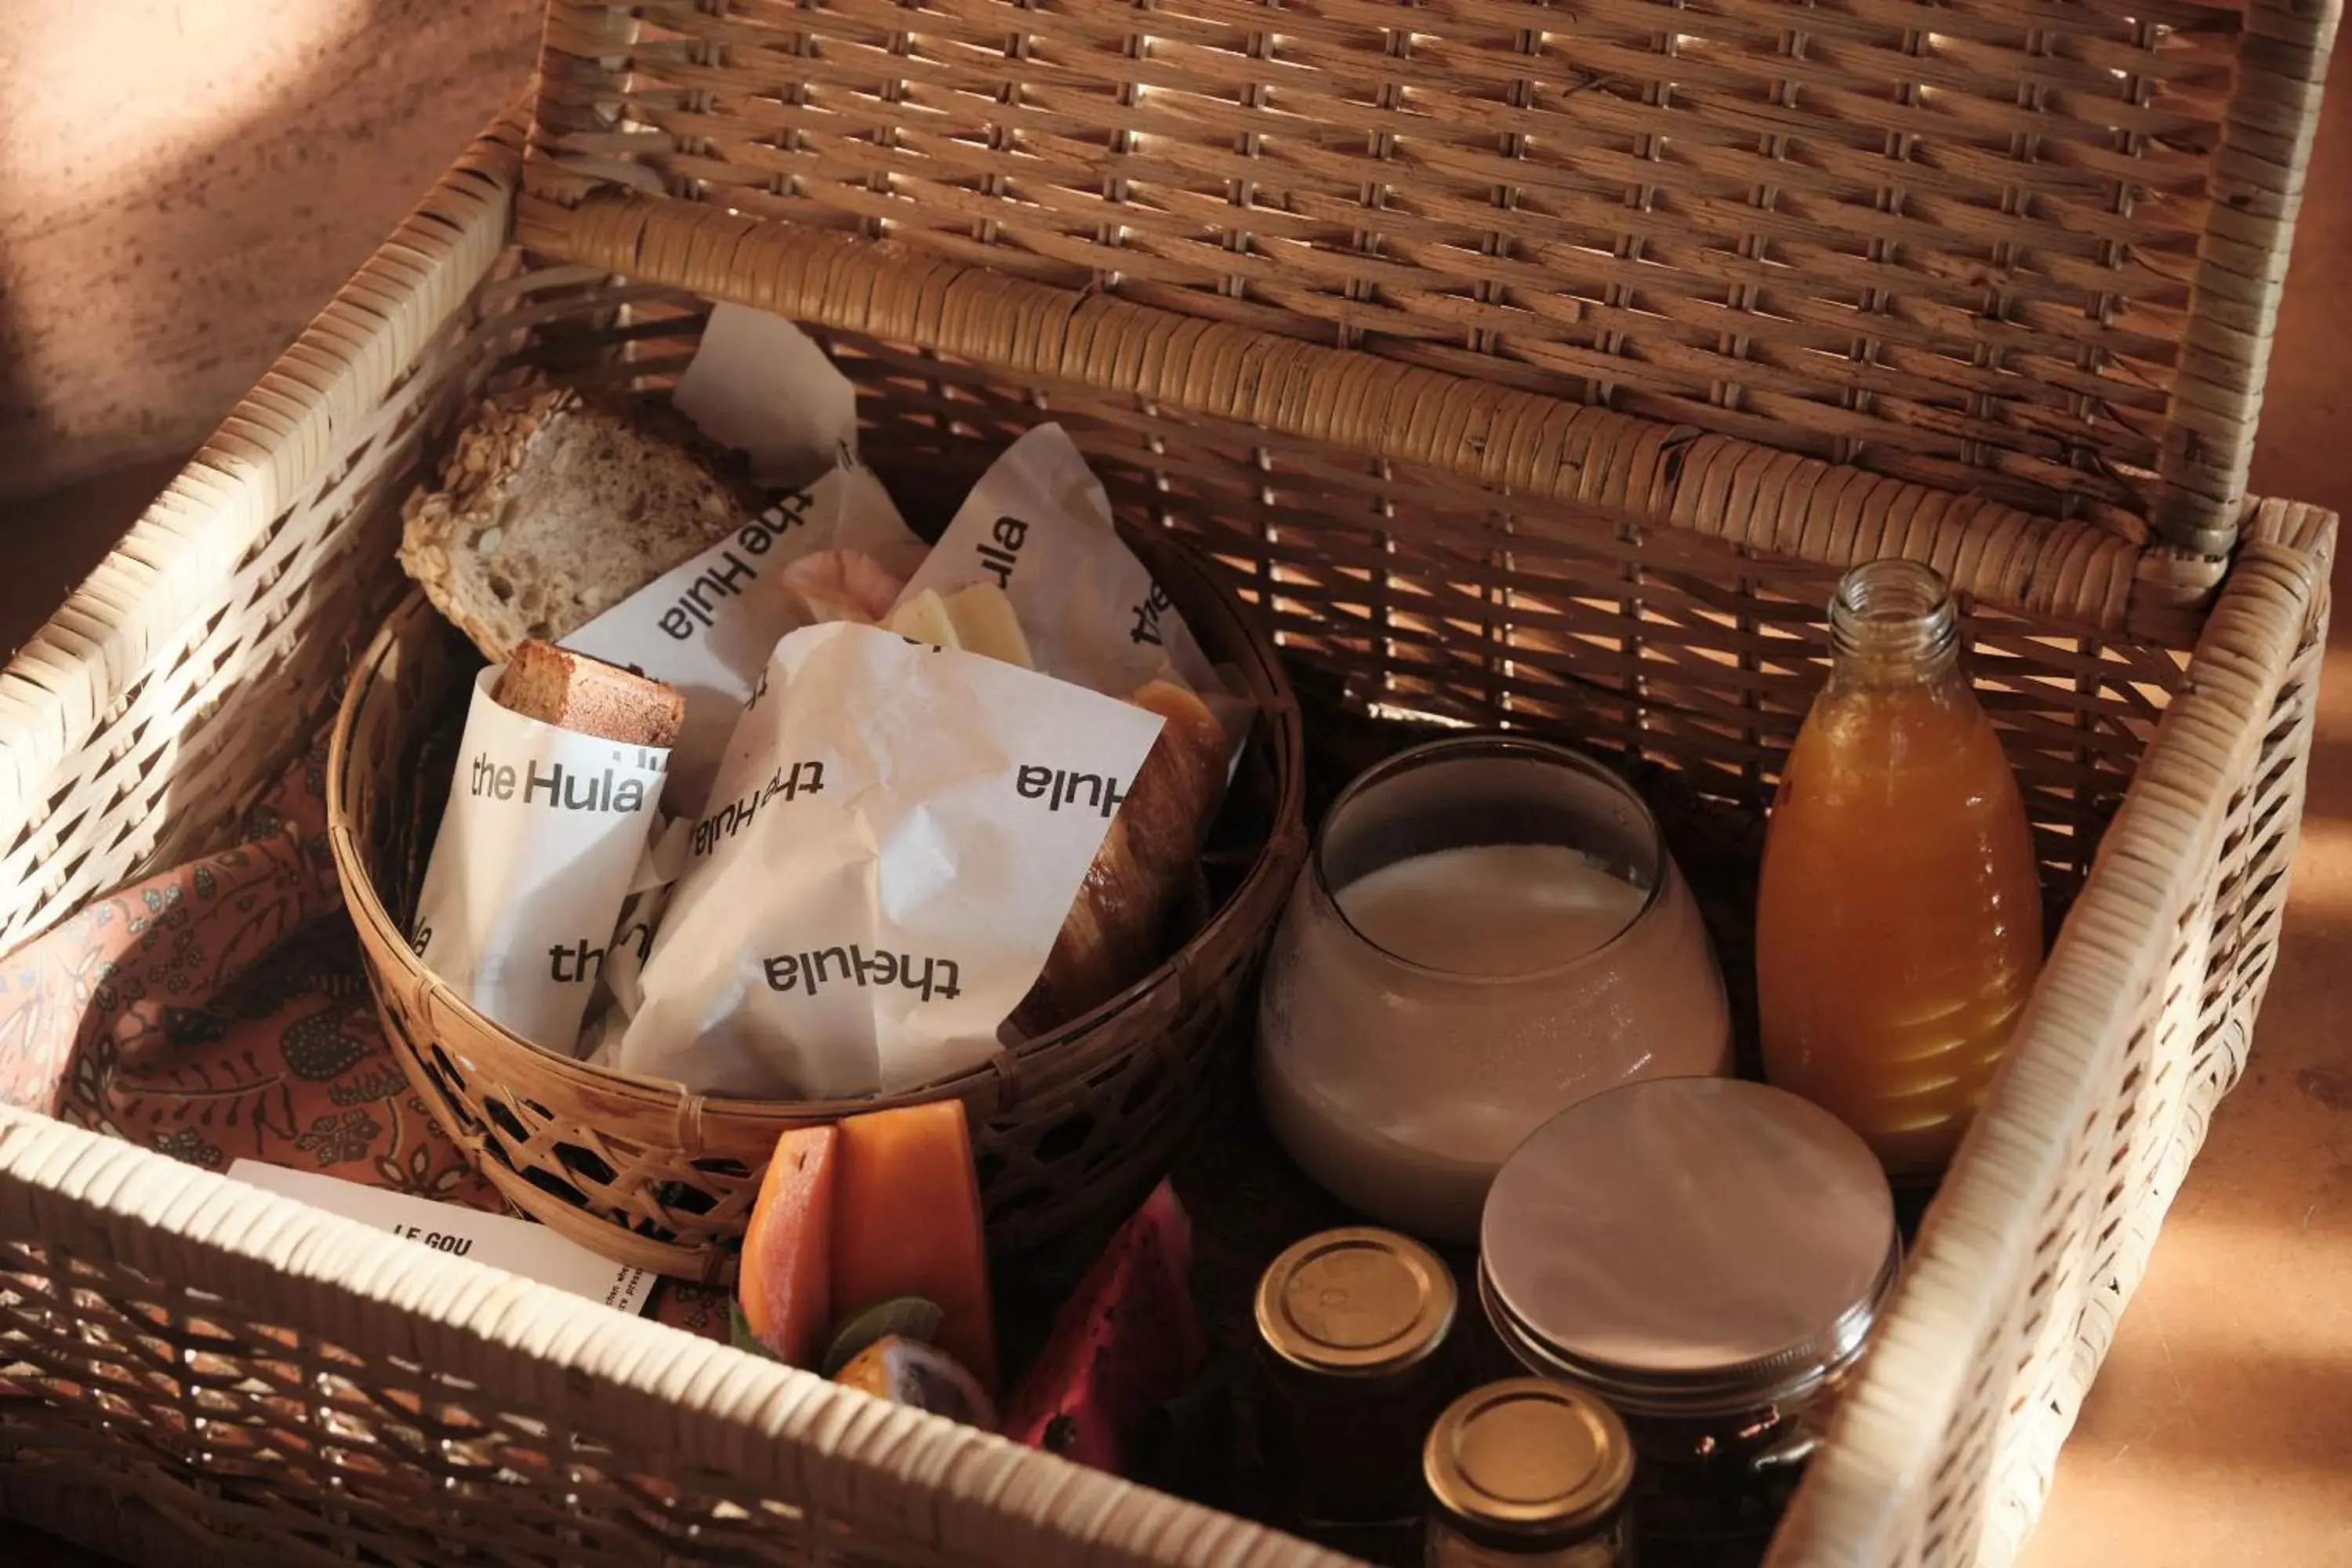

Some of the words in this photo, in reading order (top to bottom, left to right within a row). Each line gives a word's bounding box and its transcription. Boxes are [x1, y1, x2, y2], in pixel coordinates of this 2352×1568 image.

[738, 490, 814, 554] the
[658, 551, 757, 640] Hula
[471, 753, 517, 800] the
[523, 757, 644, 813] Hula
[695, 790, 760, 856] Hula
[424, 1232, 473, 1256] GOU
